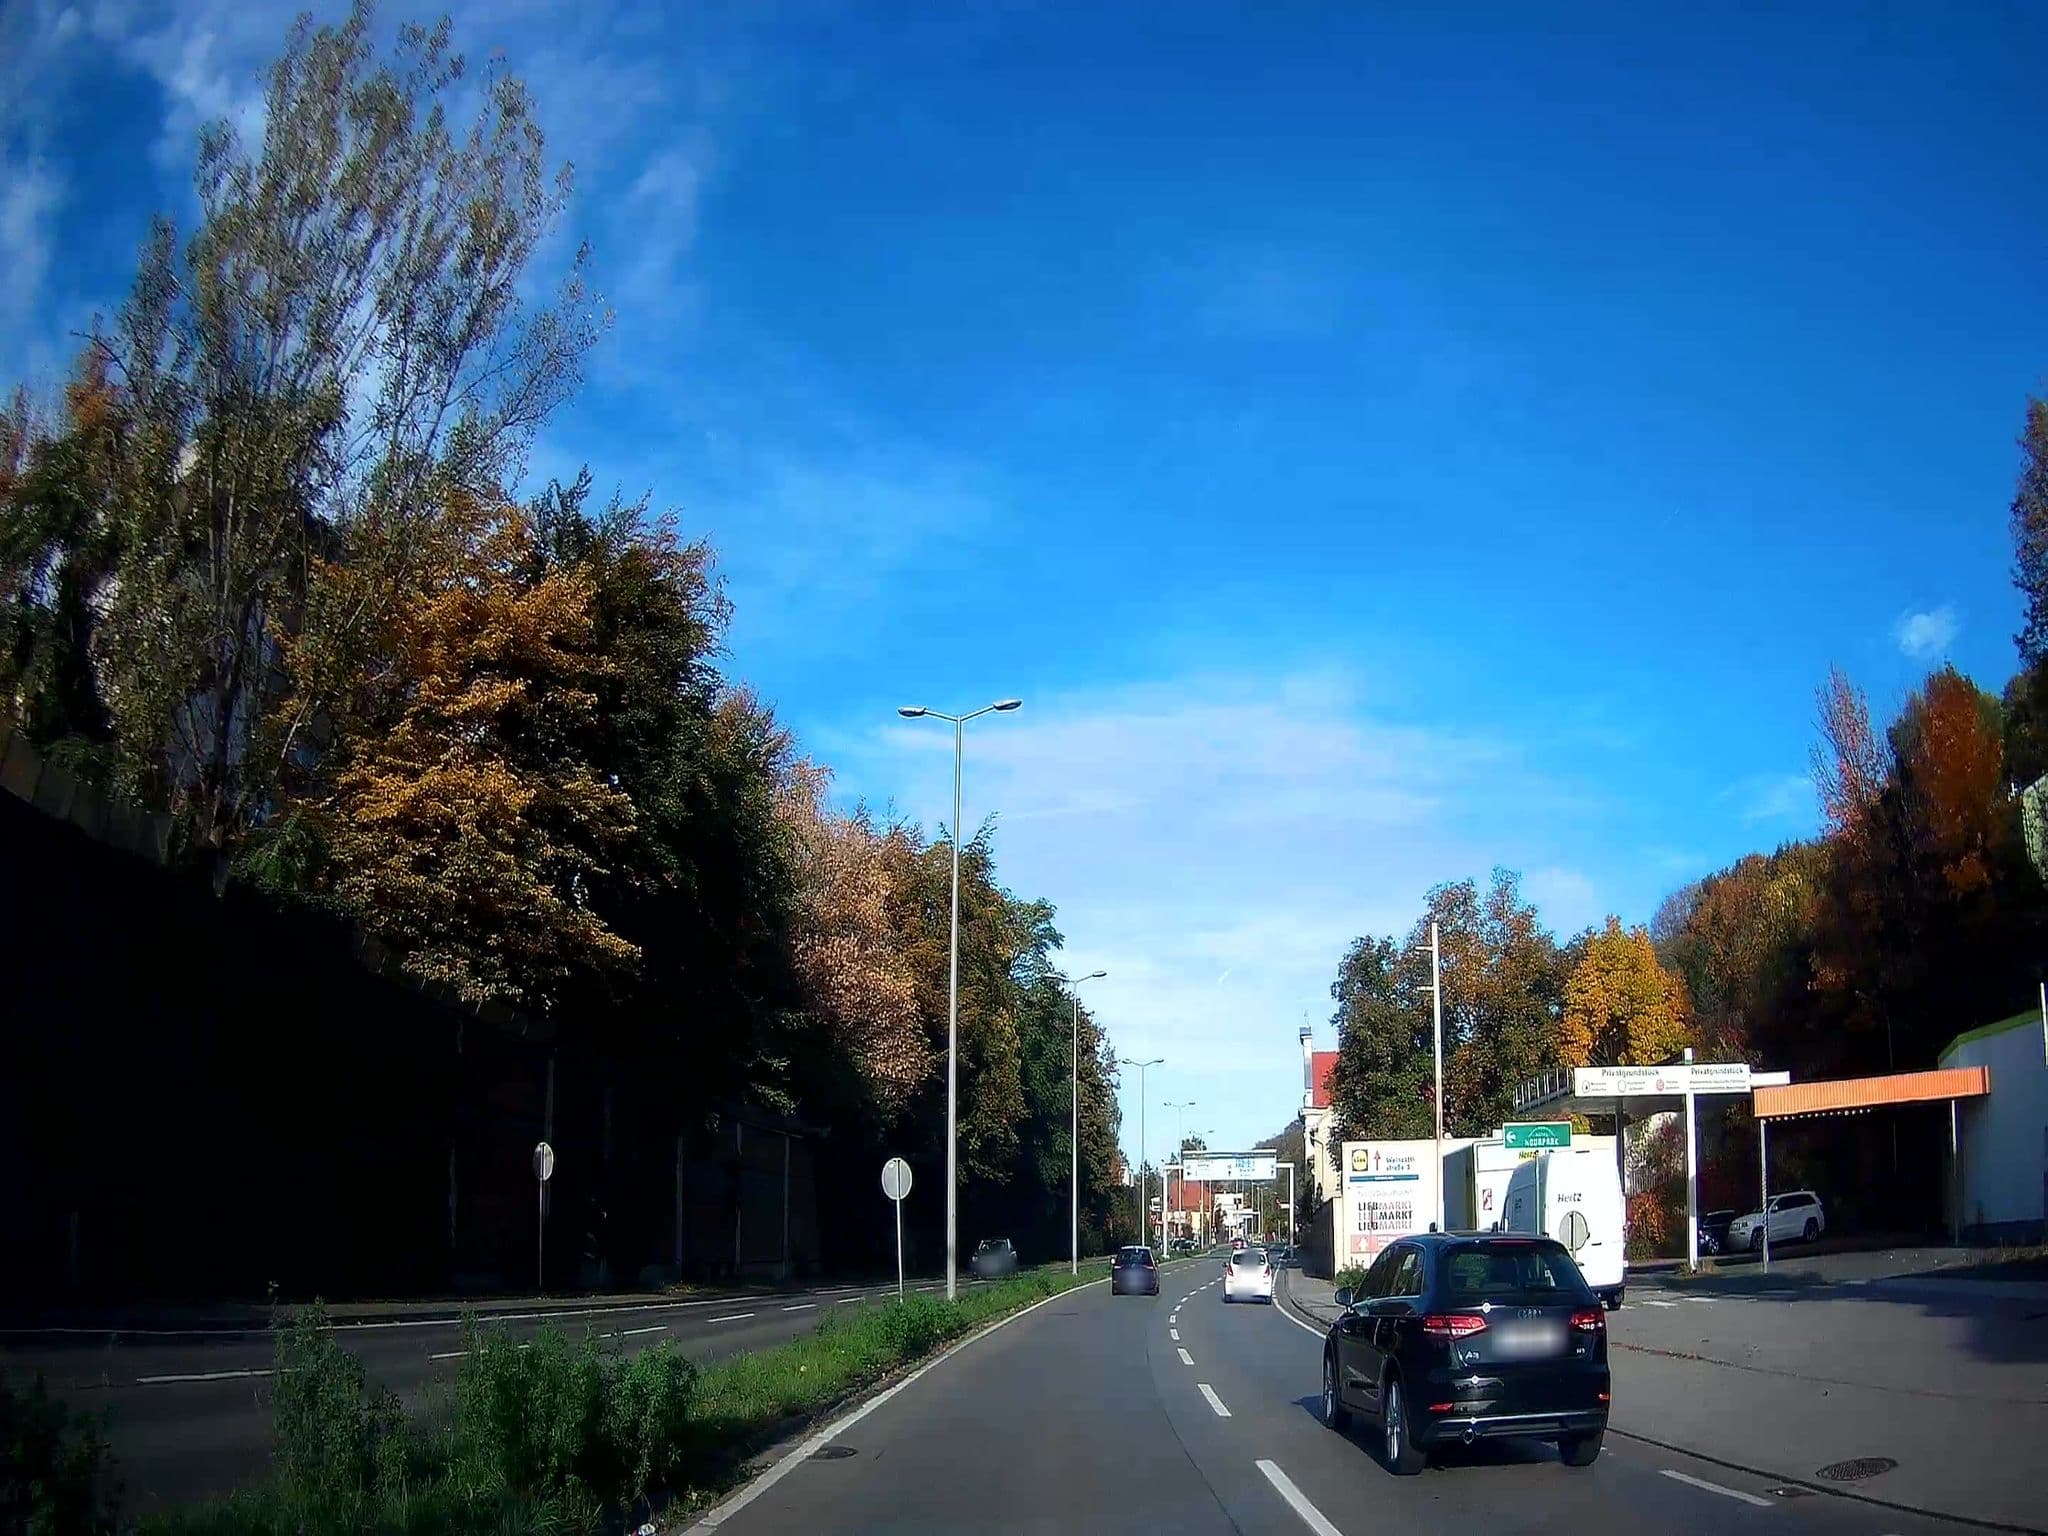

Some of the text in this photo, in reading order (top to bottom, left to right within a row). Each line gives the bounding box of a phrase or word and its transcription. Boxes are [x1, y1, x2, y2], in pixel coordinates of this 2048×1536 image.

[1558, 1193, 1582, 1202] Hertz
[1358, 1201, 1412, 1211] LIEBMARKT
[1358, 1210, 1413, 1221] LIEBMARKT
[1358, 1221, 1413, 1231] LIEBMARKT
